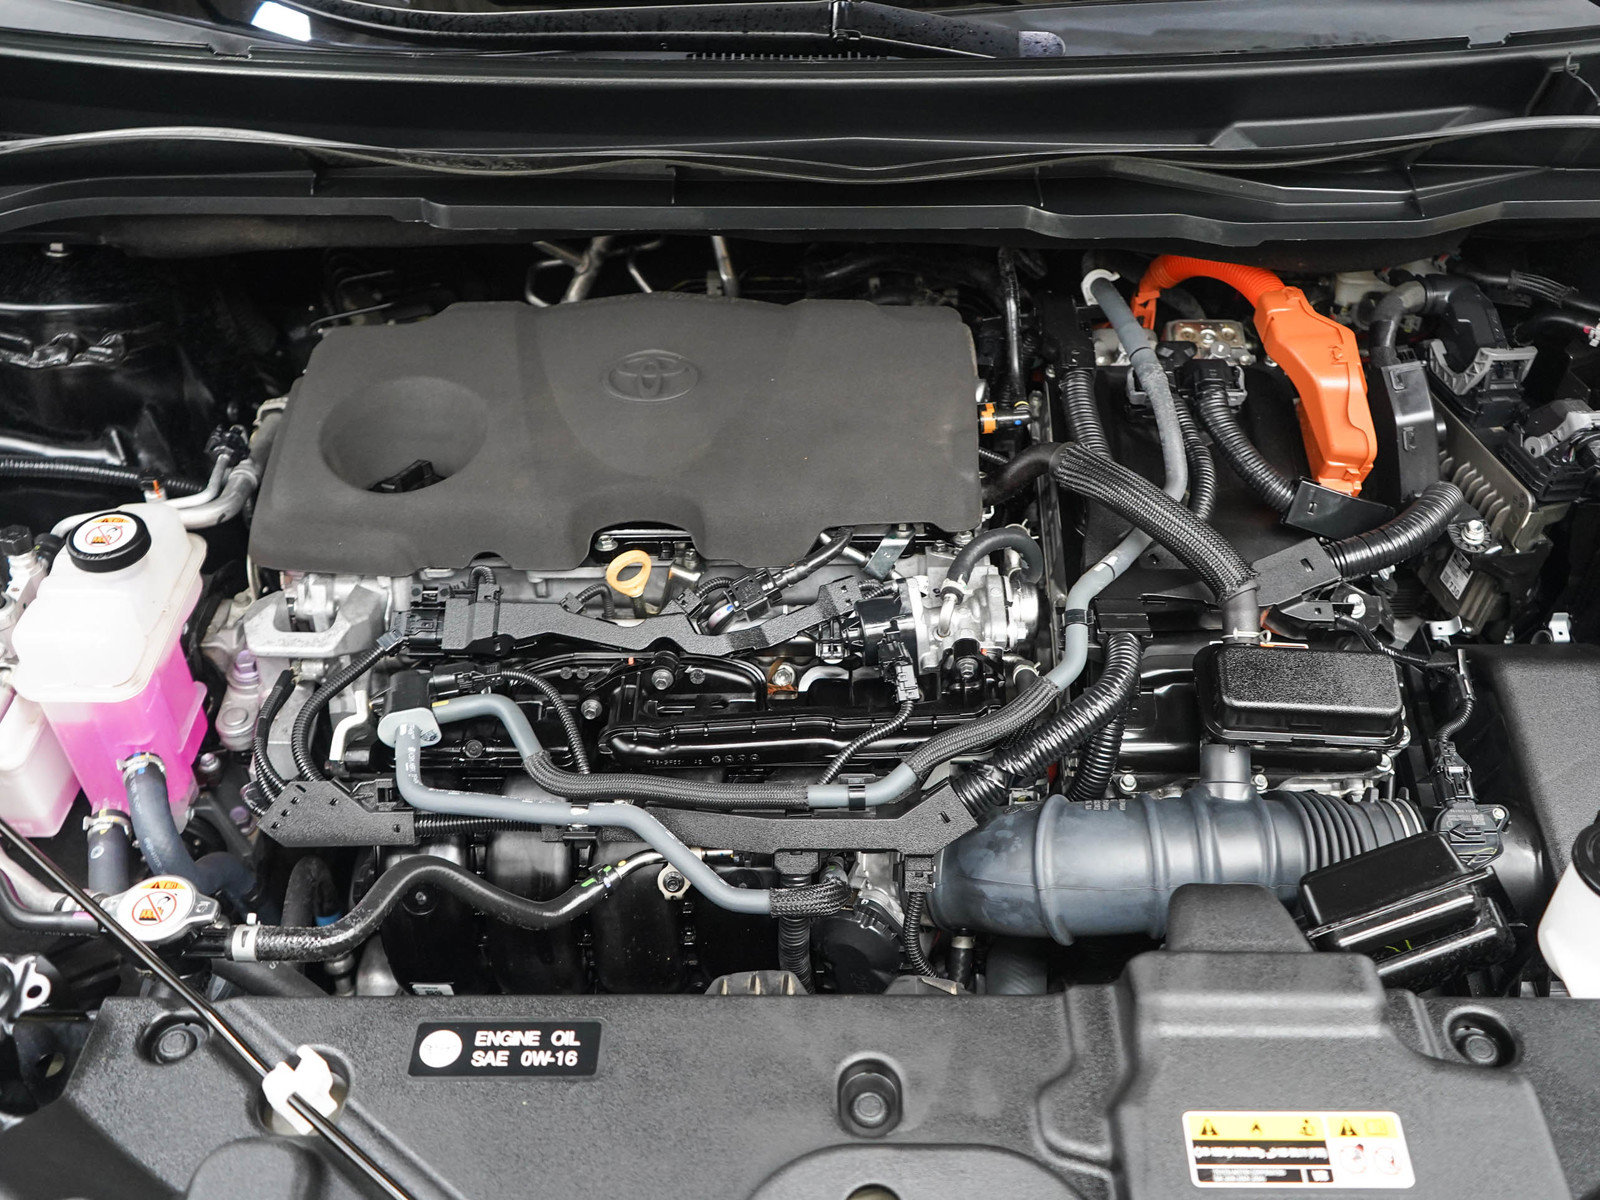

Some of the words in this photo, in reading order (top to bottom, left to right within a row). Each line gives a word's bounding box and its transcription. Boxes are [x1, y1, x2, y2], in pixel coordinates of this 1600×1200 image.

[474, 1030, 541, 1047] ENGINE
[550, 1030, 581, 1046] OIL
[470, 1050, 510, 1067] SAE
[520, 1050, 578, 1067] 0W-16
